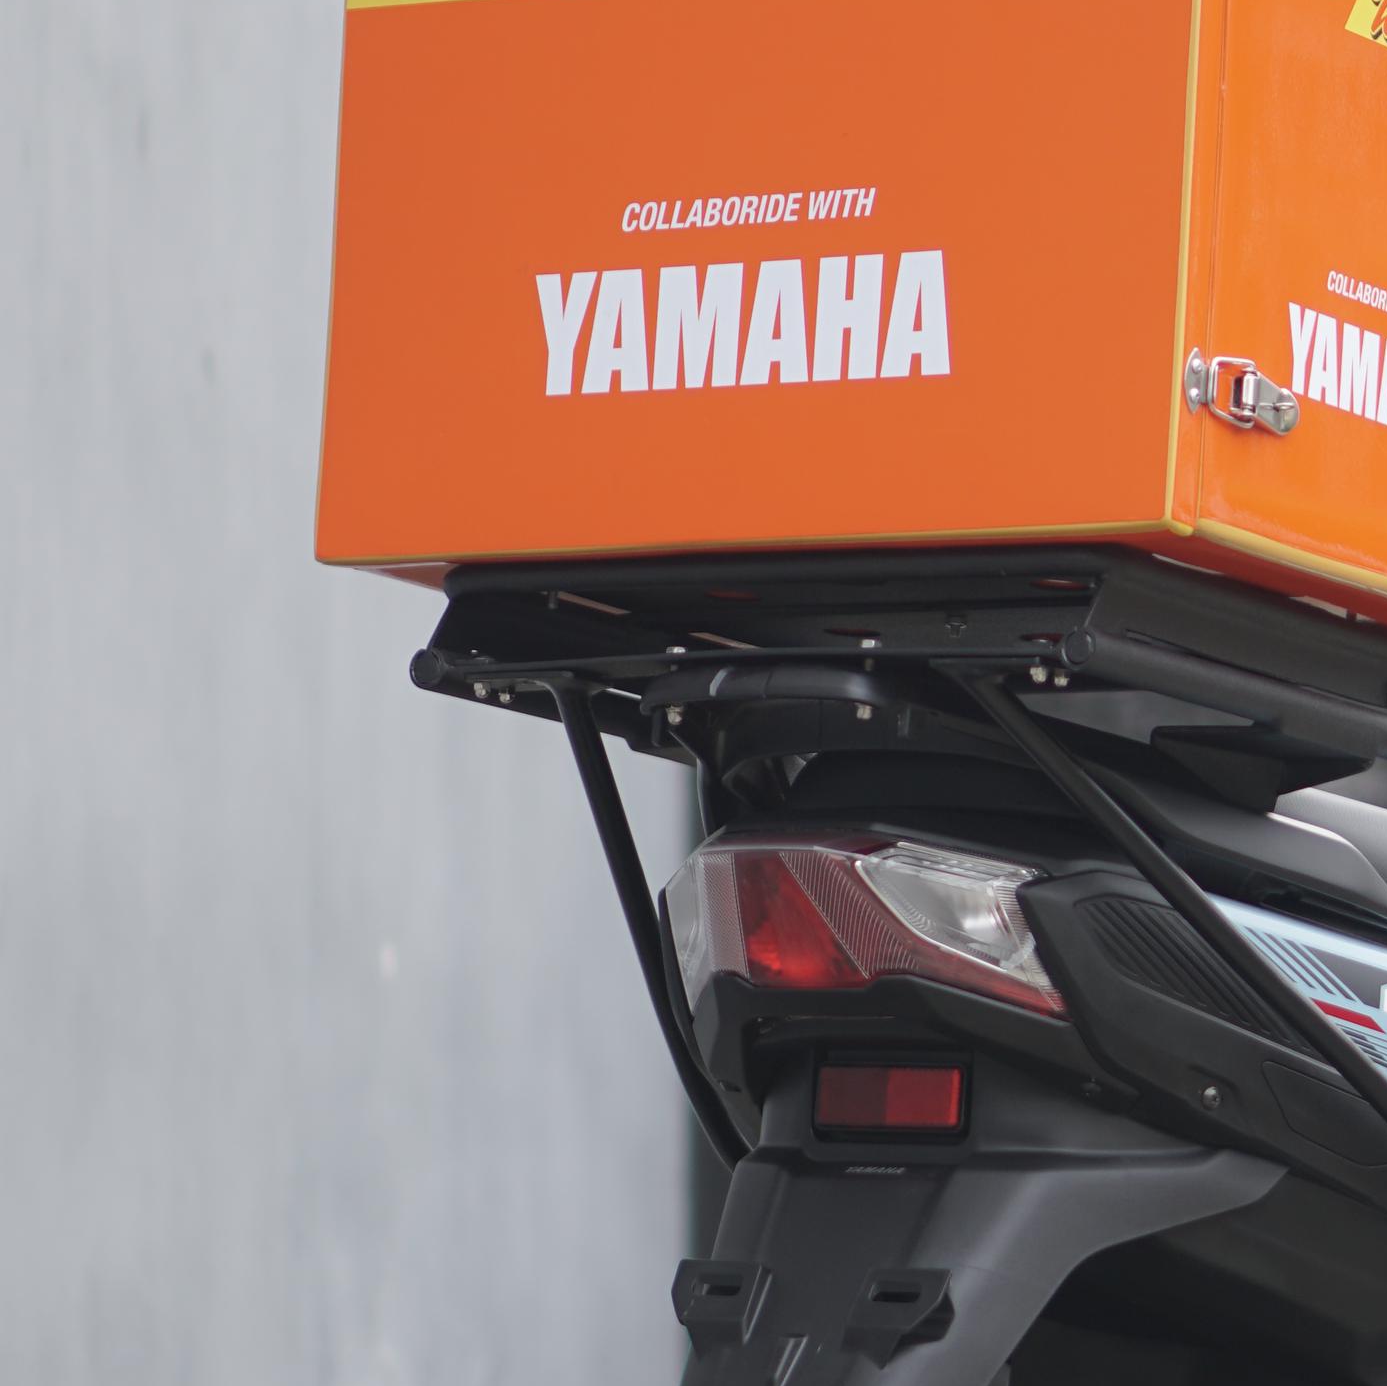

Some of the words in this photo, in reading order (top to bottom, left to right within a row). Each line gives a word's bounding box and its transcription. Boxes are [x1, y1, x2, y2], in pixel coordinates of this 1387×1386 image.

[621, 192, 802, 232] COLLABORIDE
[808, 187, 876, 219] WITH
[535, 250, 951, 396] YAMAHA
